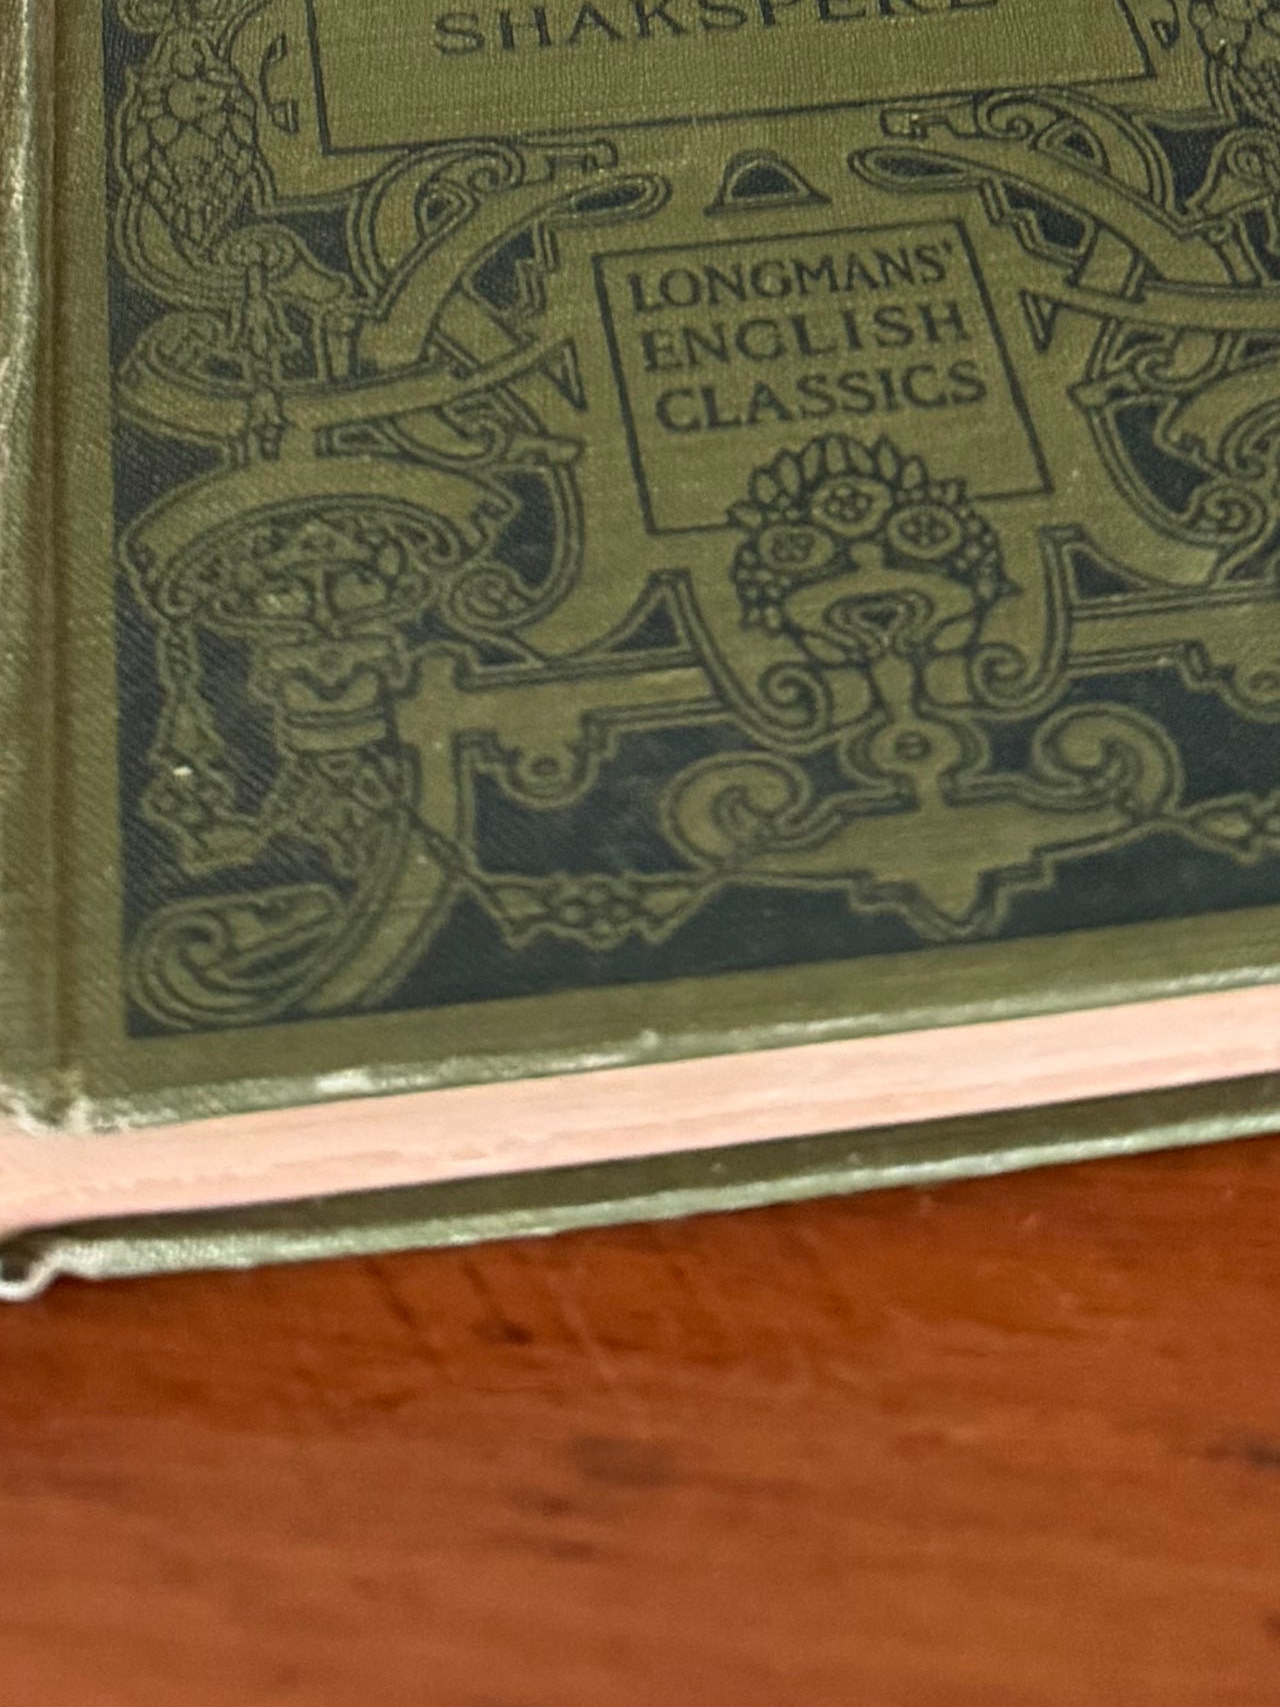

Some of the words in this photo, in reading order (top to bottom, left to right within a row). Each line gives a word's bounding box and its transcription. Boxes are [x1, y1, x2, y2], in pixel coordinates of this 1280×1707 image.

[629, 242, 957, 313] LONGMANS'
[640, 304, 969, 373] ENGLISH
[654, 360, 988, 434] CLASSICS
